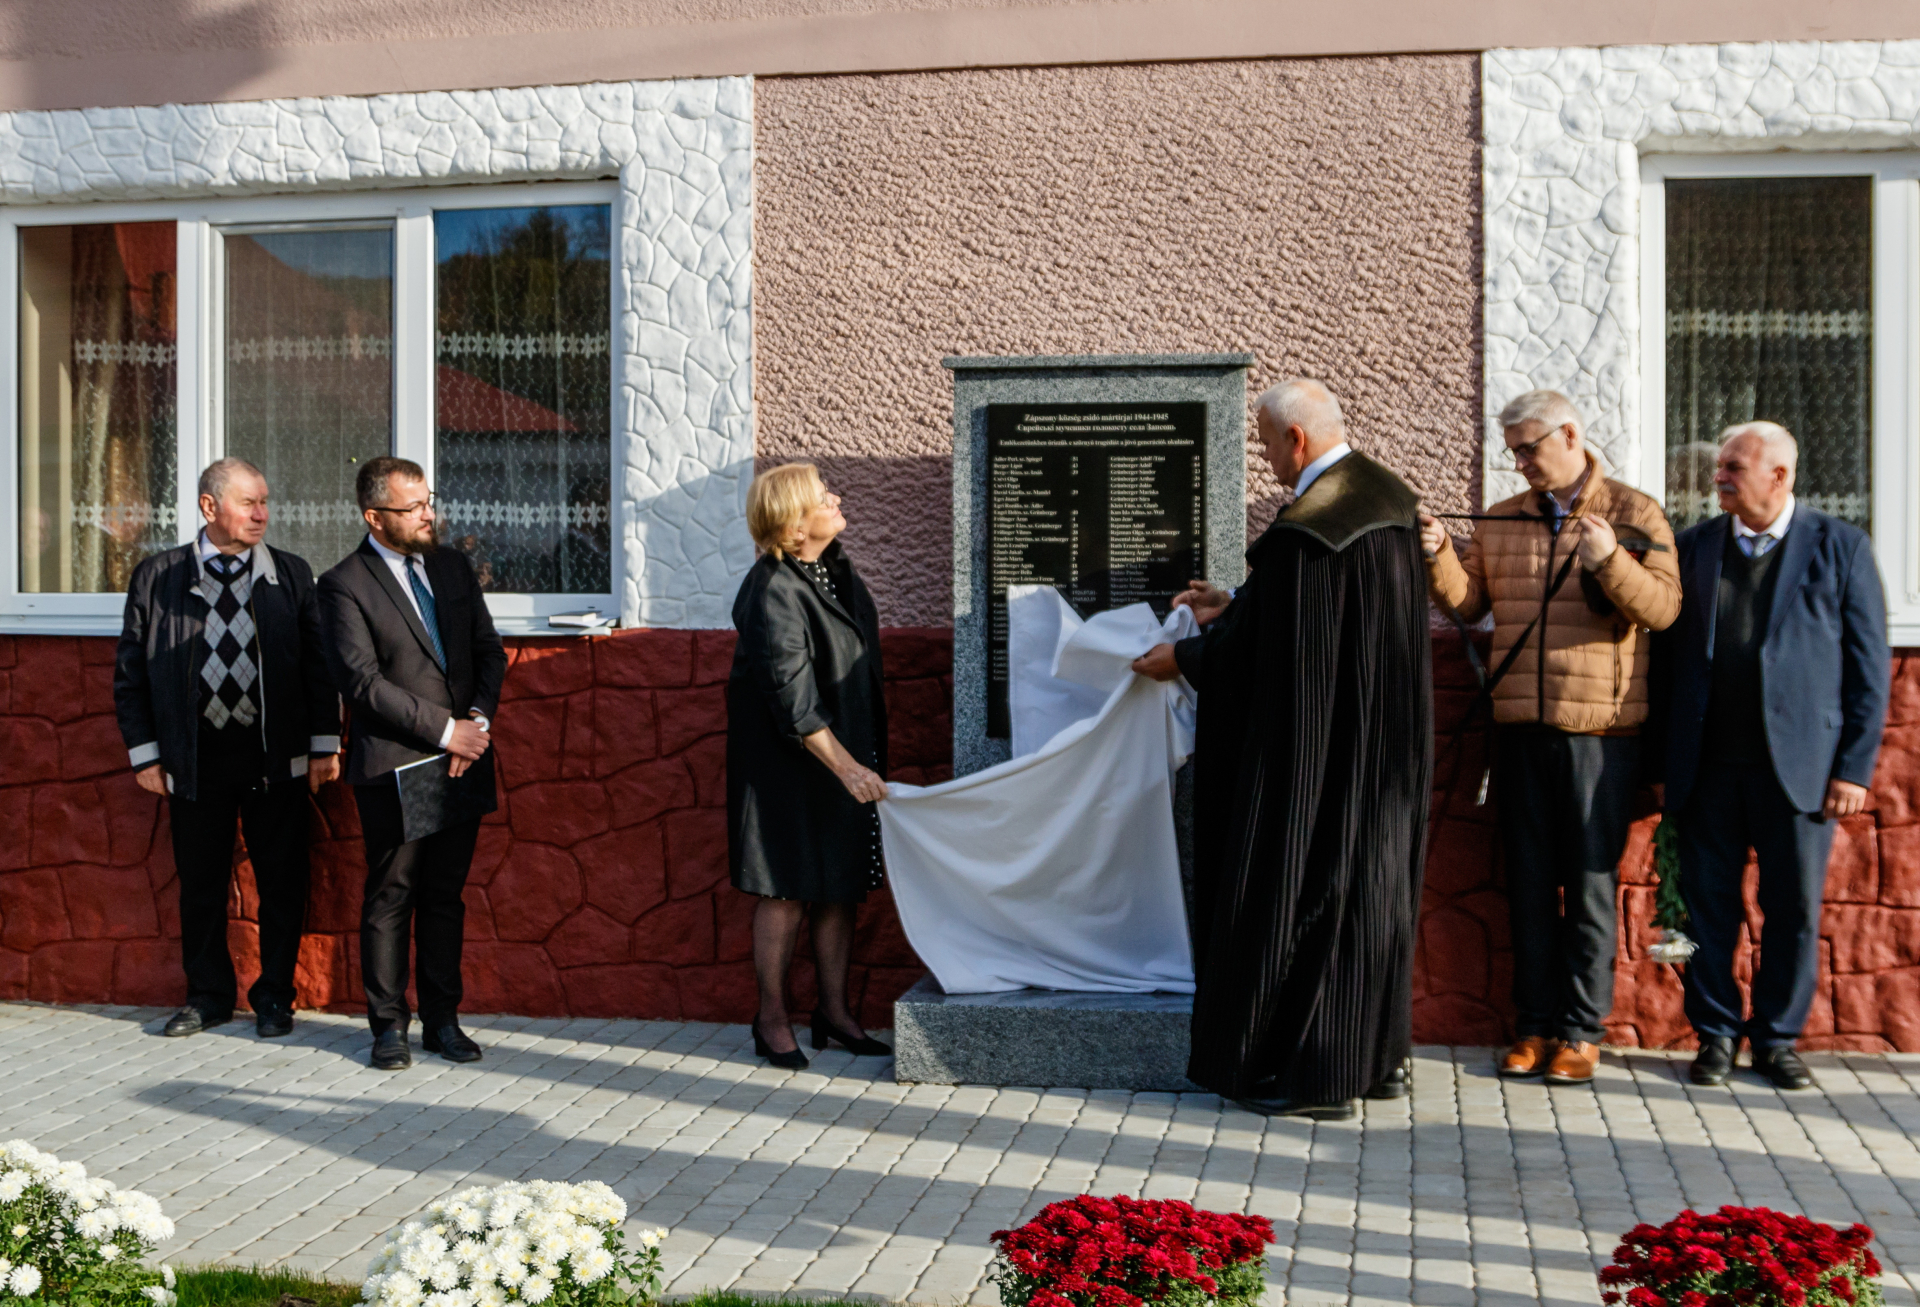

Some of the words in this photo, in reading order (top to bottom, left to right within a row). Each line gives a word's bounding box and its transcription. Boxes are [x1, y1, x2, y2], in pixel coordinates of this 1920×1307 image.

[1025, 414, 1057, 423] Zápszony
[1058, 414, 1081, 423] község
[1083, 413, 1100, 421] zsidó
[1134, 413, 1168, 421] 1944-1945
[1055, 424, 1091, 432] мученики
